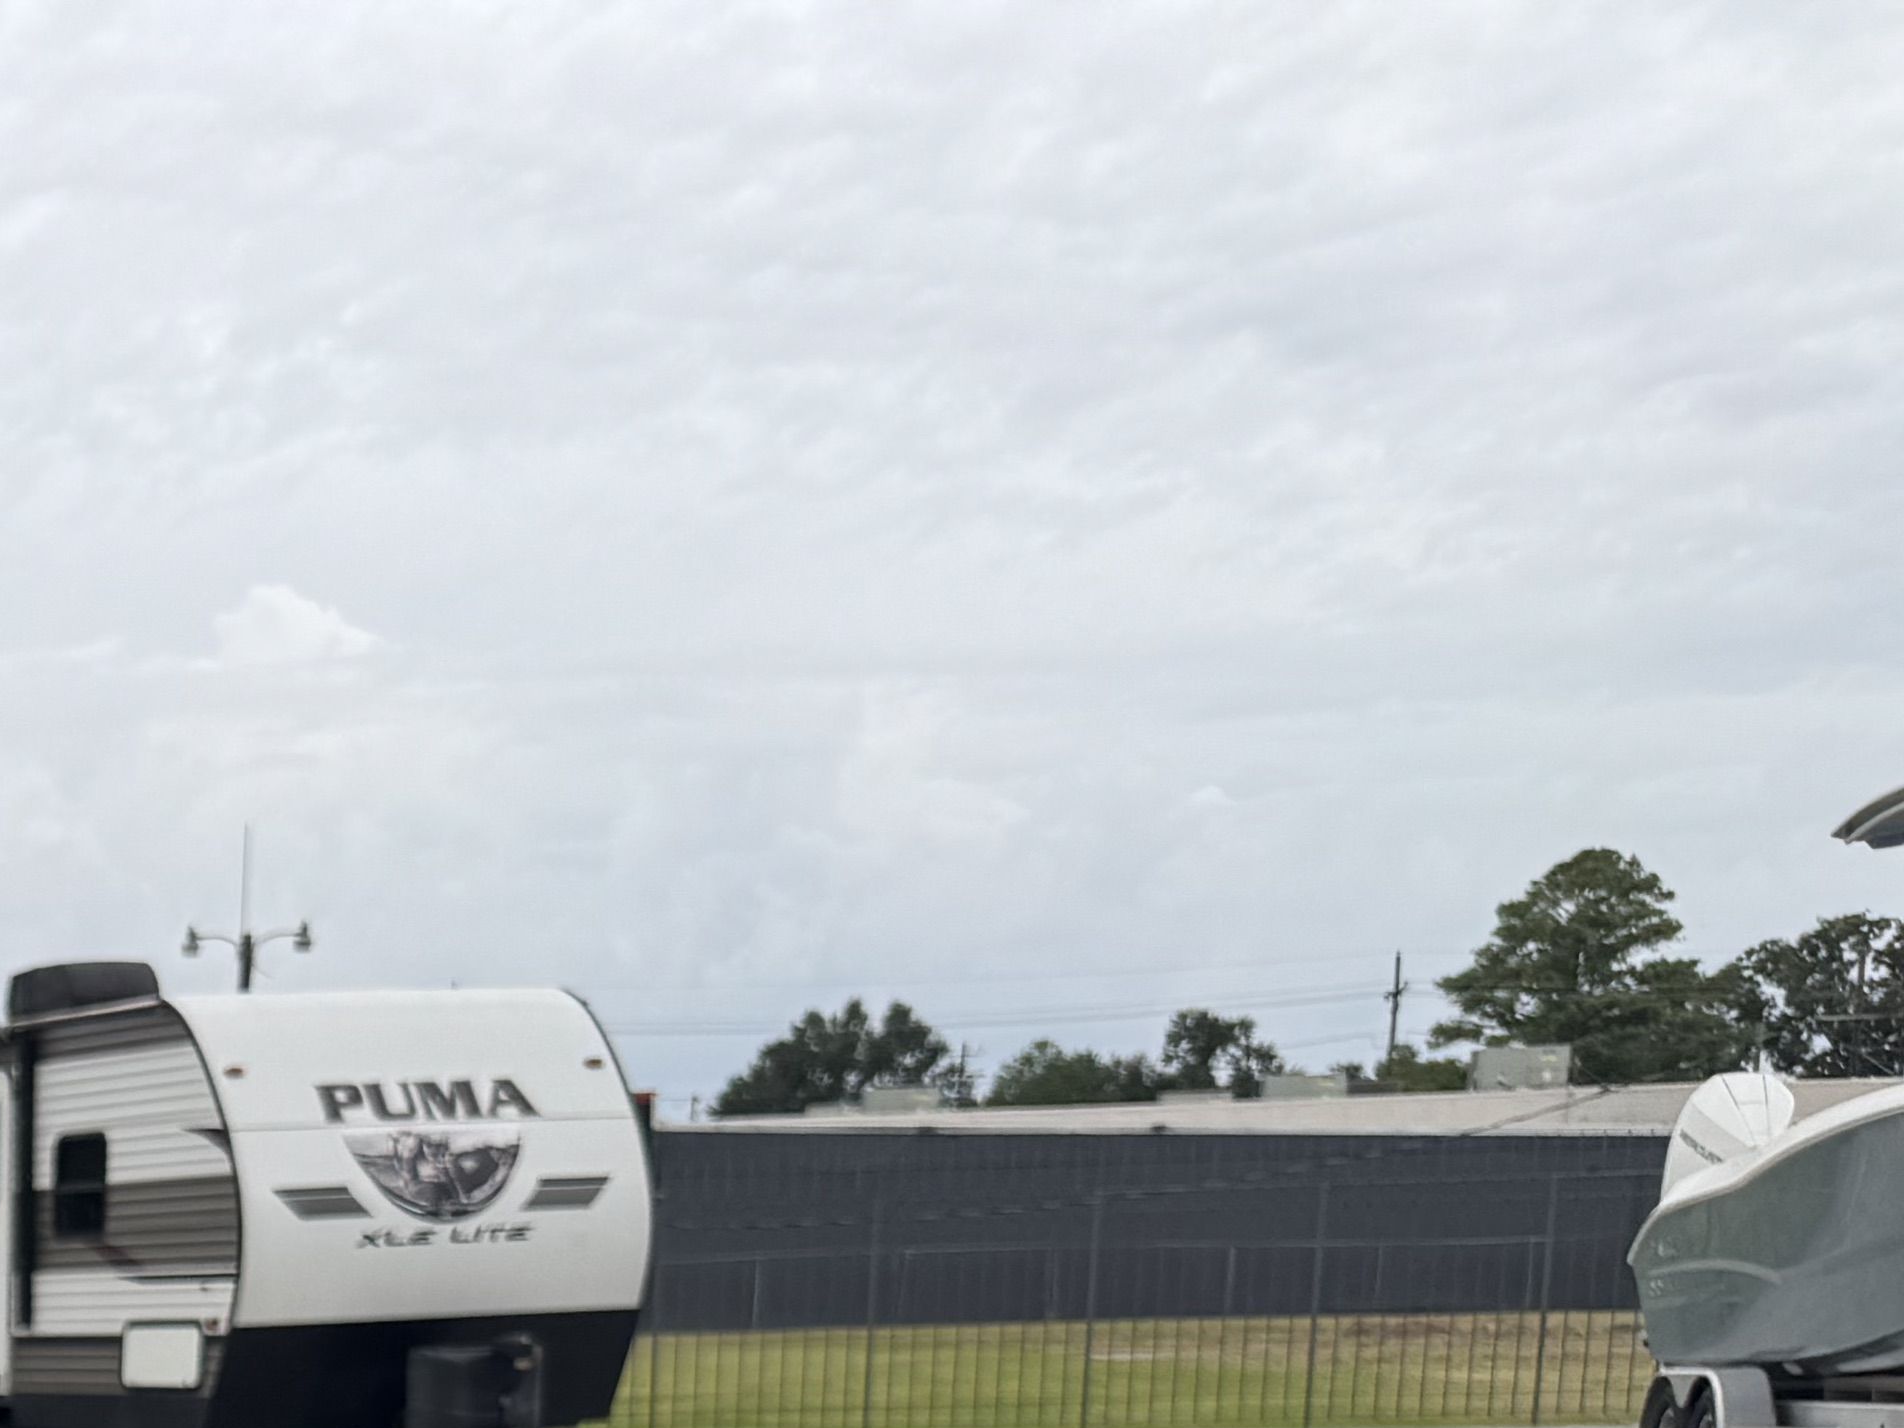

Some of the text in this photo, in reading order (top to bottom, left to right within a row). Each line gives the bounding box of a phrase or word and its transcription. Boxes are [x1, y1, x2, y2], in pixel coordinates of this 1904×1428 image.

[314, 1079, 542, 1123] PUMA
[357, 1222, 533, 1249] XLE LITE
